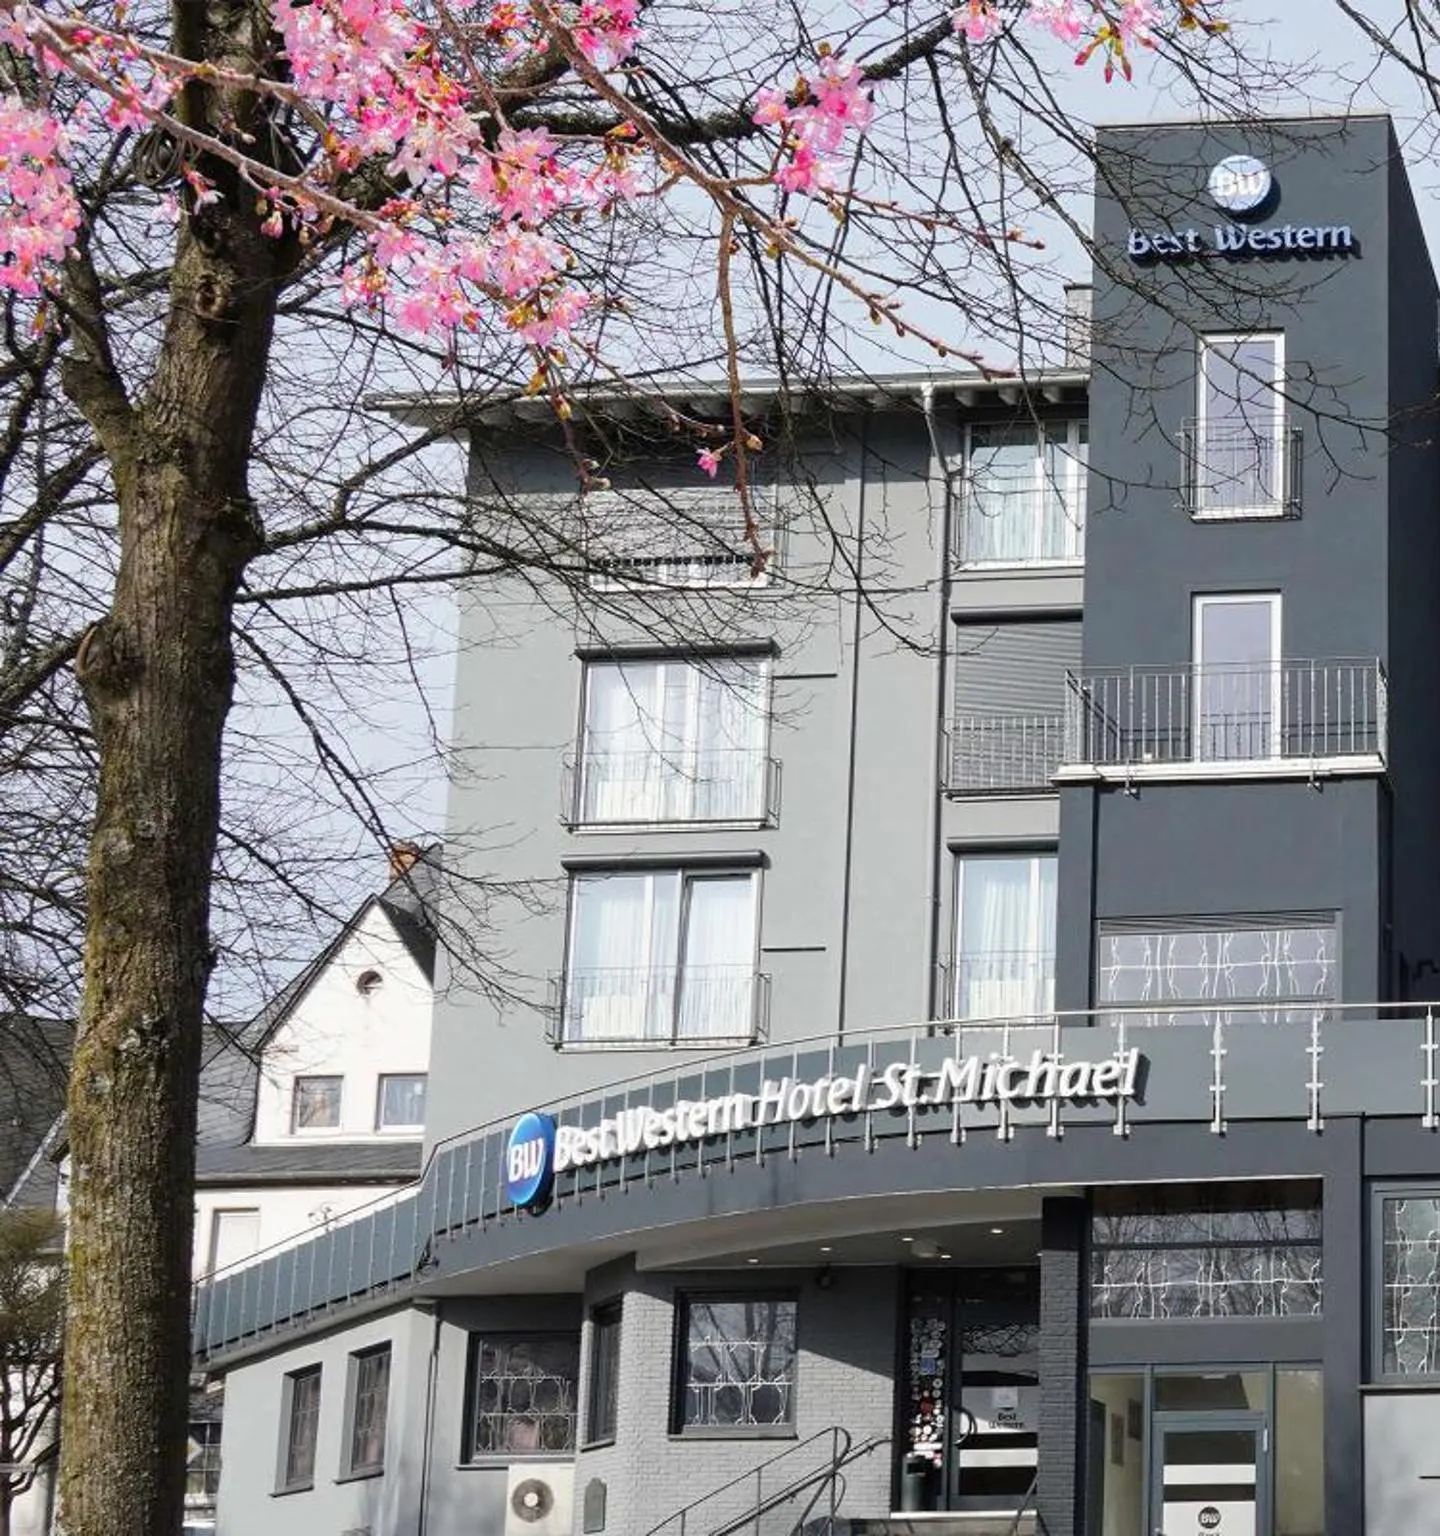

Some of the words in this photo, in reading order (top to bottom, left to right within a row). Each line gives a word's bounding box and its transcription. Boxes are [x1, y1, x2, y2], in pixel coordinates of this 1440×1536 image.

[1128, 226, 1200, 255] Best
[1215, 223, 1352, 251] Western
[553, 1119, 617, 1172] Best
[616, 1093, 757, 1153] Western
[754, 1064, 867, 1126] Hotel
[935, 1047, 1140, 1104] Michael
[508, 1137, 545, 1183] BW
